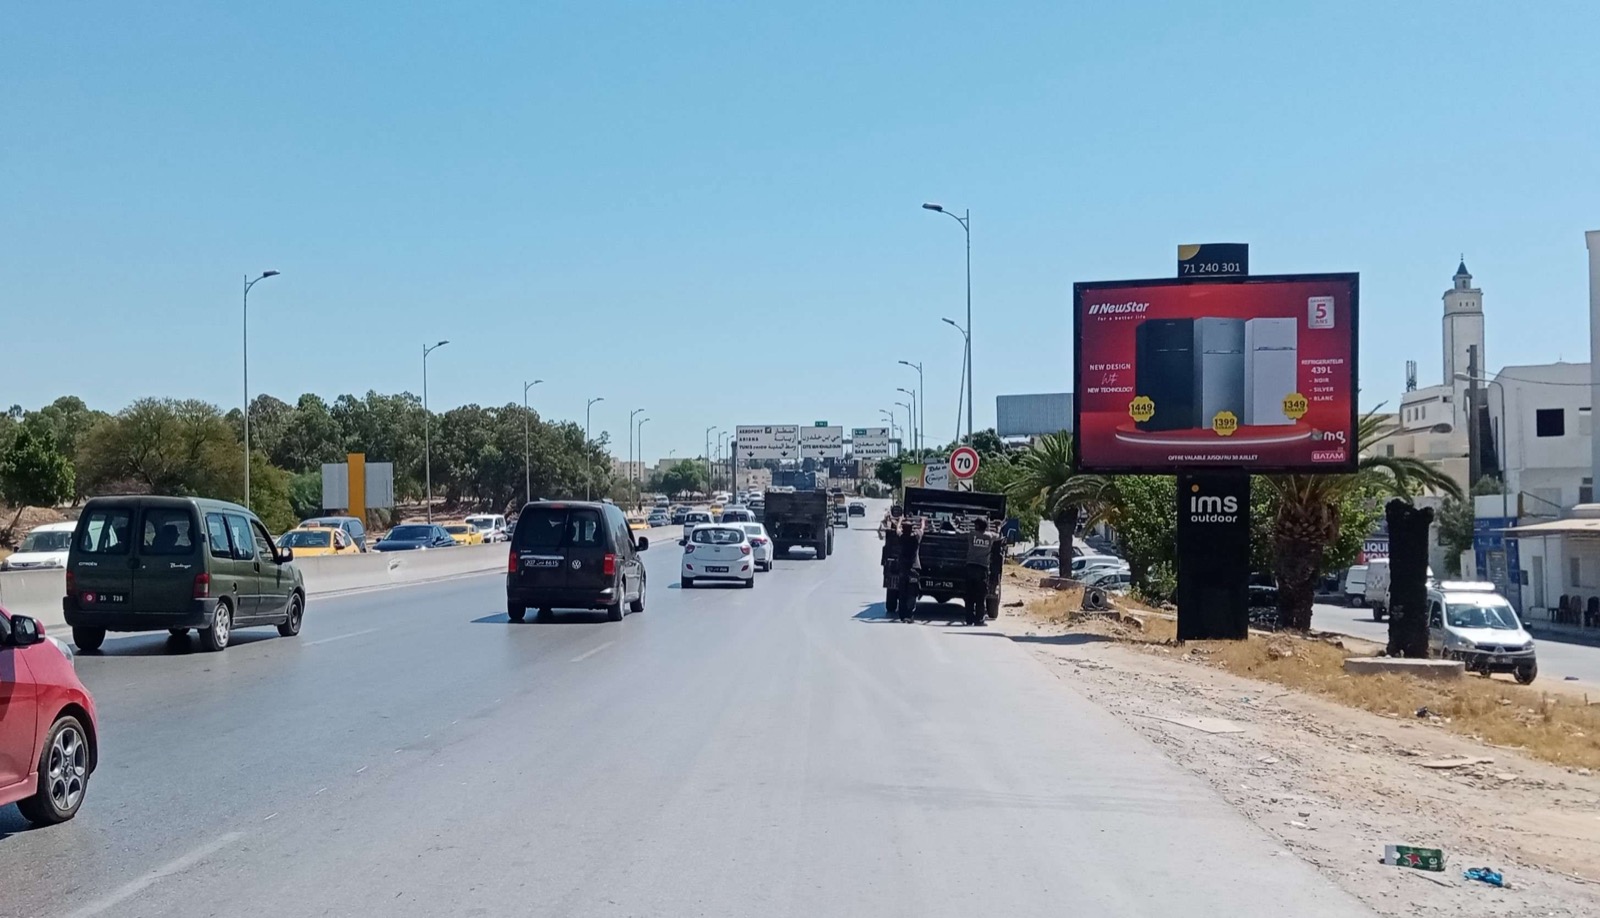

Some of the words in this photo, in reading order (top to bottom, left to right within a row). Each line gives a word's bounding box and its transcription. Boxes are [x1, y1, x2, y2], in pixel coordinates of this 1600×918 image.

[1184, 264, 1195, 273] 71
[1199, 263, 1219, 272] 240
[1222, 263, 1240, 272] 301
[1100, 302, 1149, 314] NewStar
[1315, 303, 1327, 319] 5
[1311, 366, 1326, 374] 439
[1131, 403, 1152, 411] 1449
[1284, 400, 1305, 408] 1349
[1215, 418, 1235, 427] 1399
[957, 458, 971, 469] 70
[1191, 484, 1238, 513] ims
[1191, 514, 1238, 523] outdoor
[973, 535, 990, 545] ims
